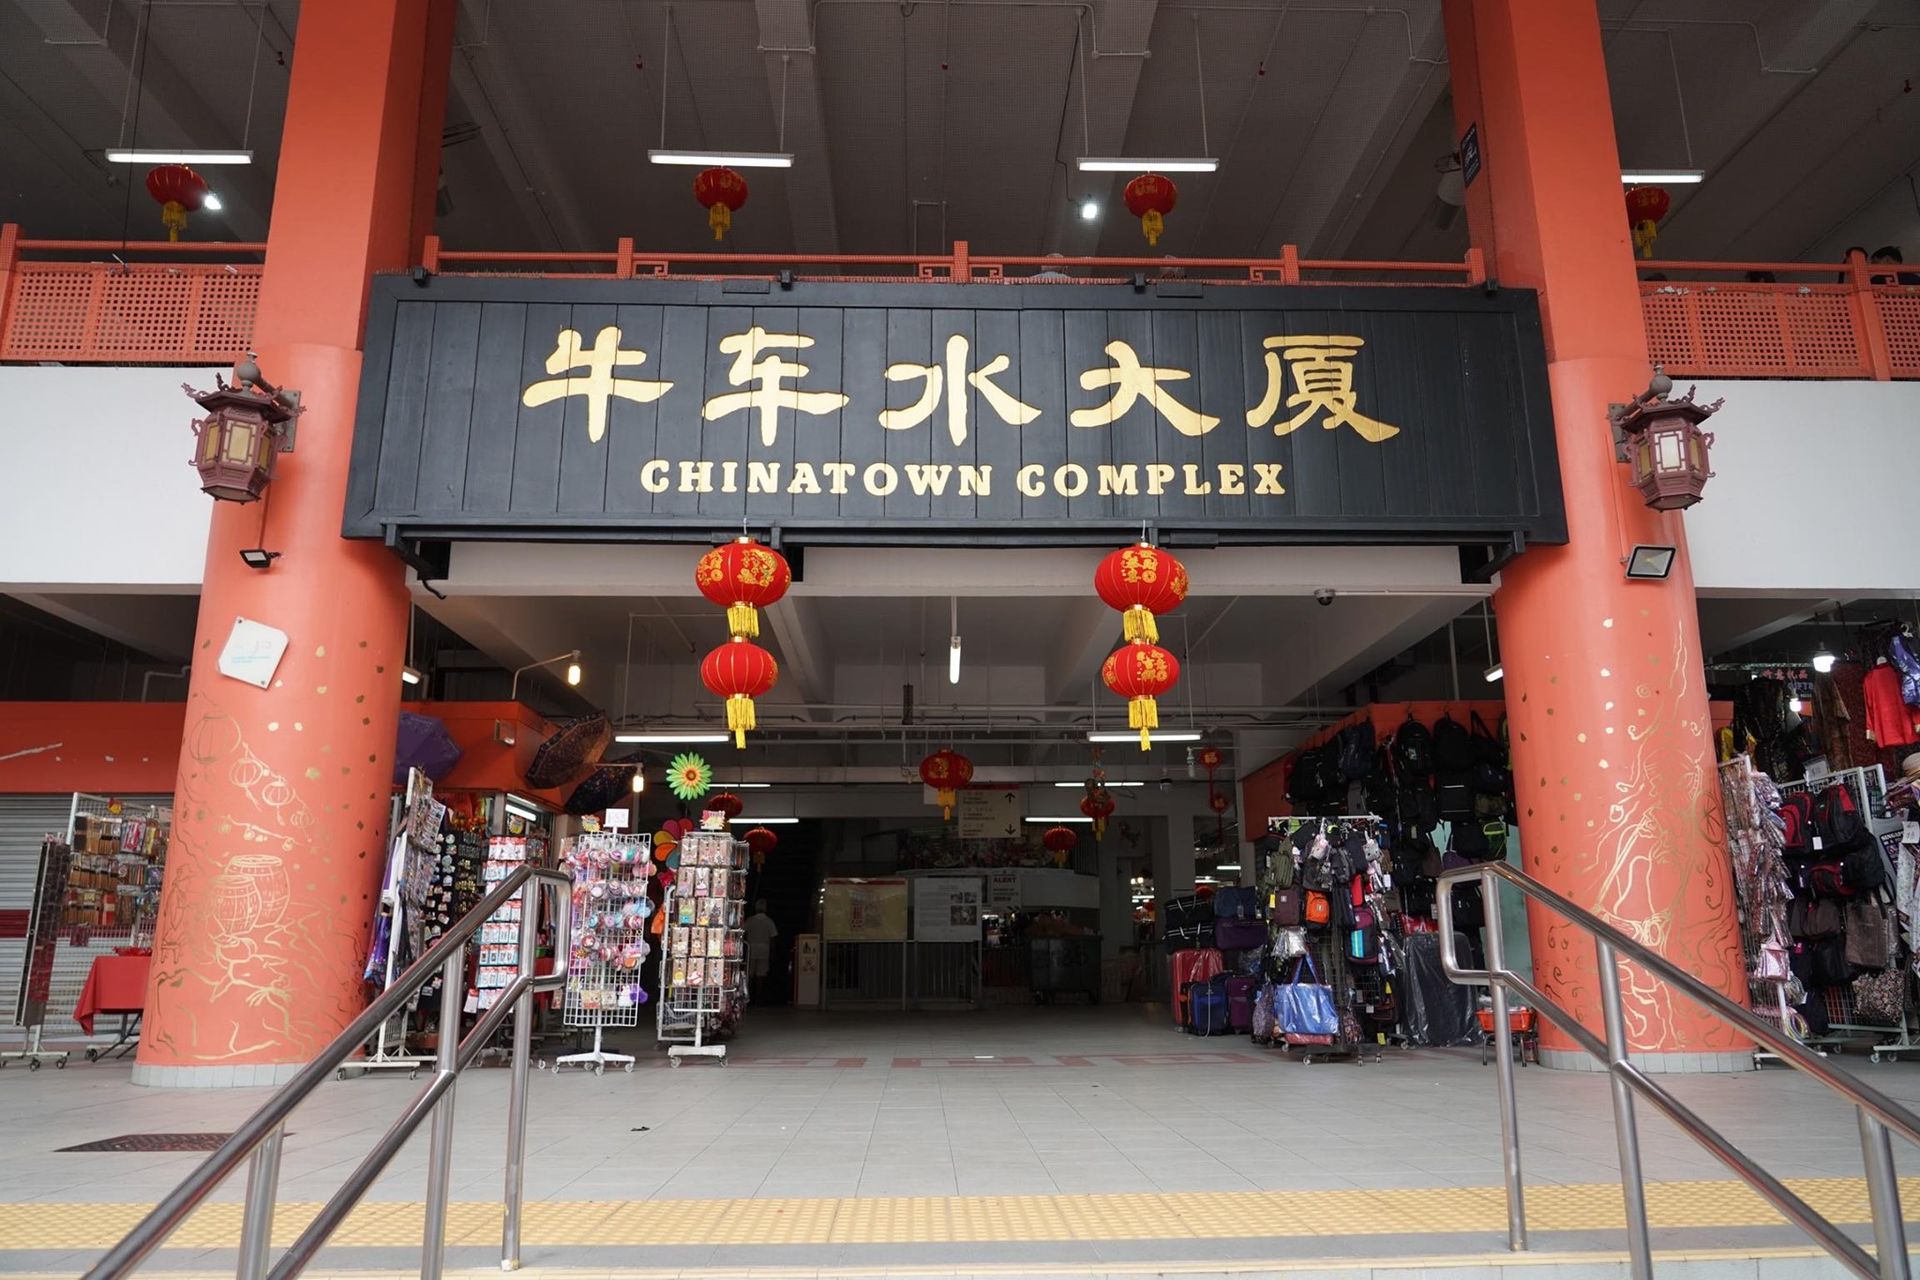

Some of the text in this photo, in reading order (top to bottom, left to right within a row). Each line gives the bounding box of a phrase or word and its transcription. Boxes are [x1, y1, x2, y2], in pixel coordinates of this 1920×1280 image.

[523, 326, 1400, 446] 牛车水大厦
[641, 460, 1286, 497] CHINATOWN COMPLEX
